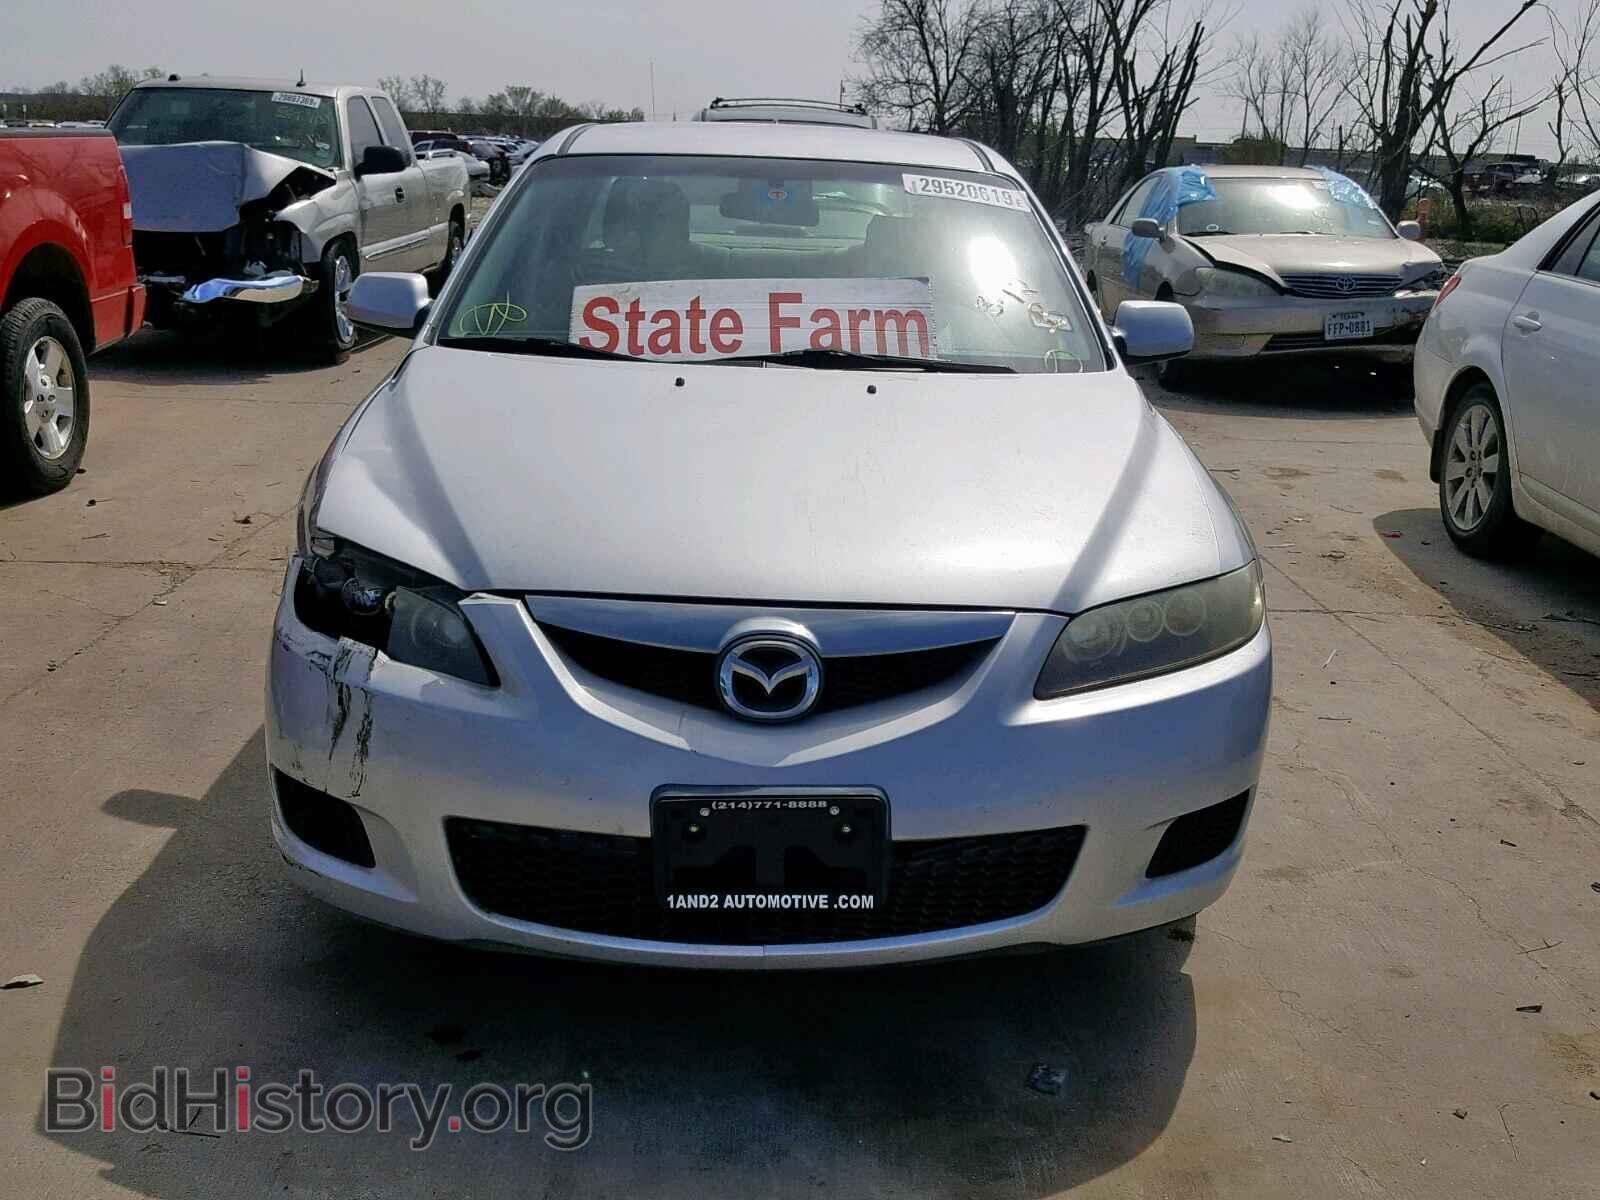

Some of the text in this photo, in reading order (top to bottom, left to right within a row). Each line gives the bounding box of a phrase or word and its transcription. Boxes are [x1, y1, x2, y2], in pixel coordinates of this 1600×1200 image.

[920, 178, 1013, 206] 29520619
[579, 296, 743, 356] State
[769, 292, 928, 357] Farm
[711, 800, 828, 810] (214)771-8888
[667, 894, 874, 910] 1AND2 AUTOMOTIVE .COM
